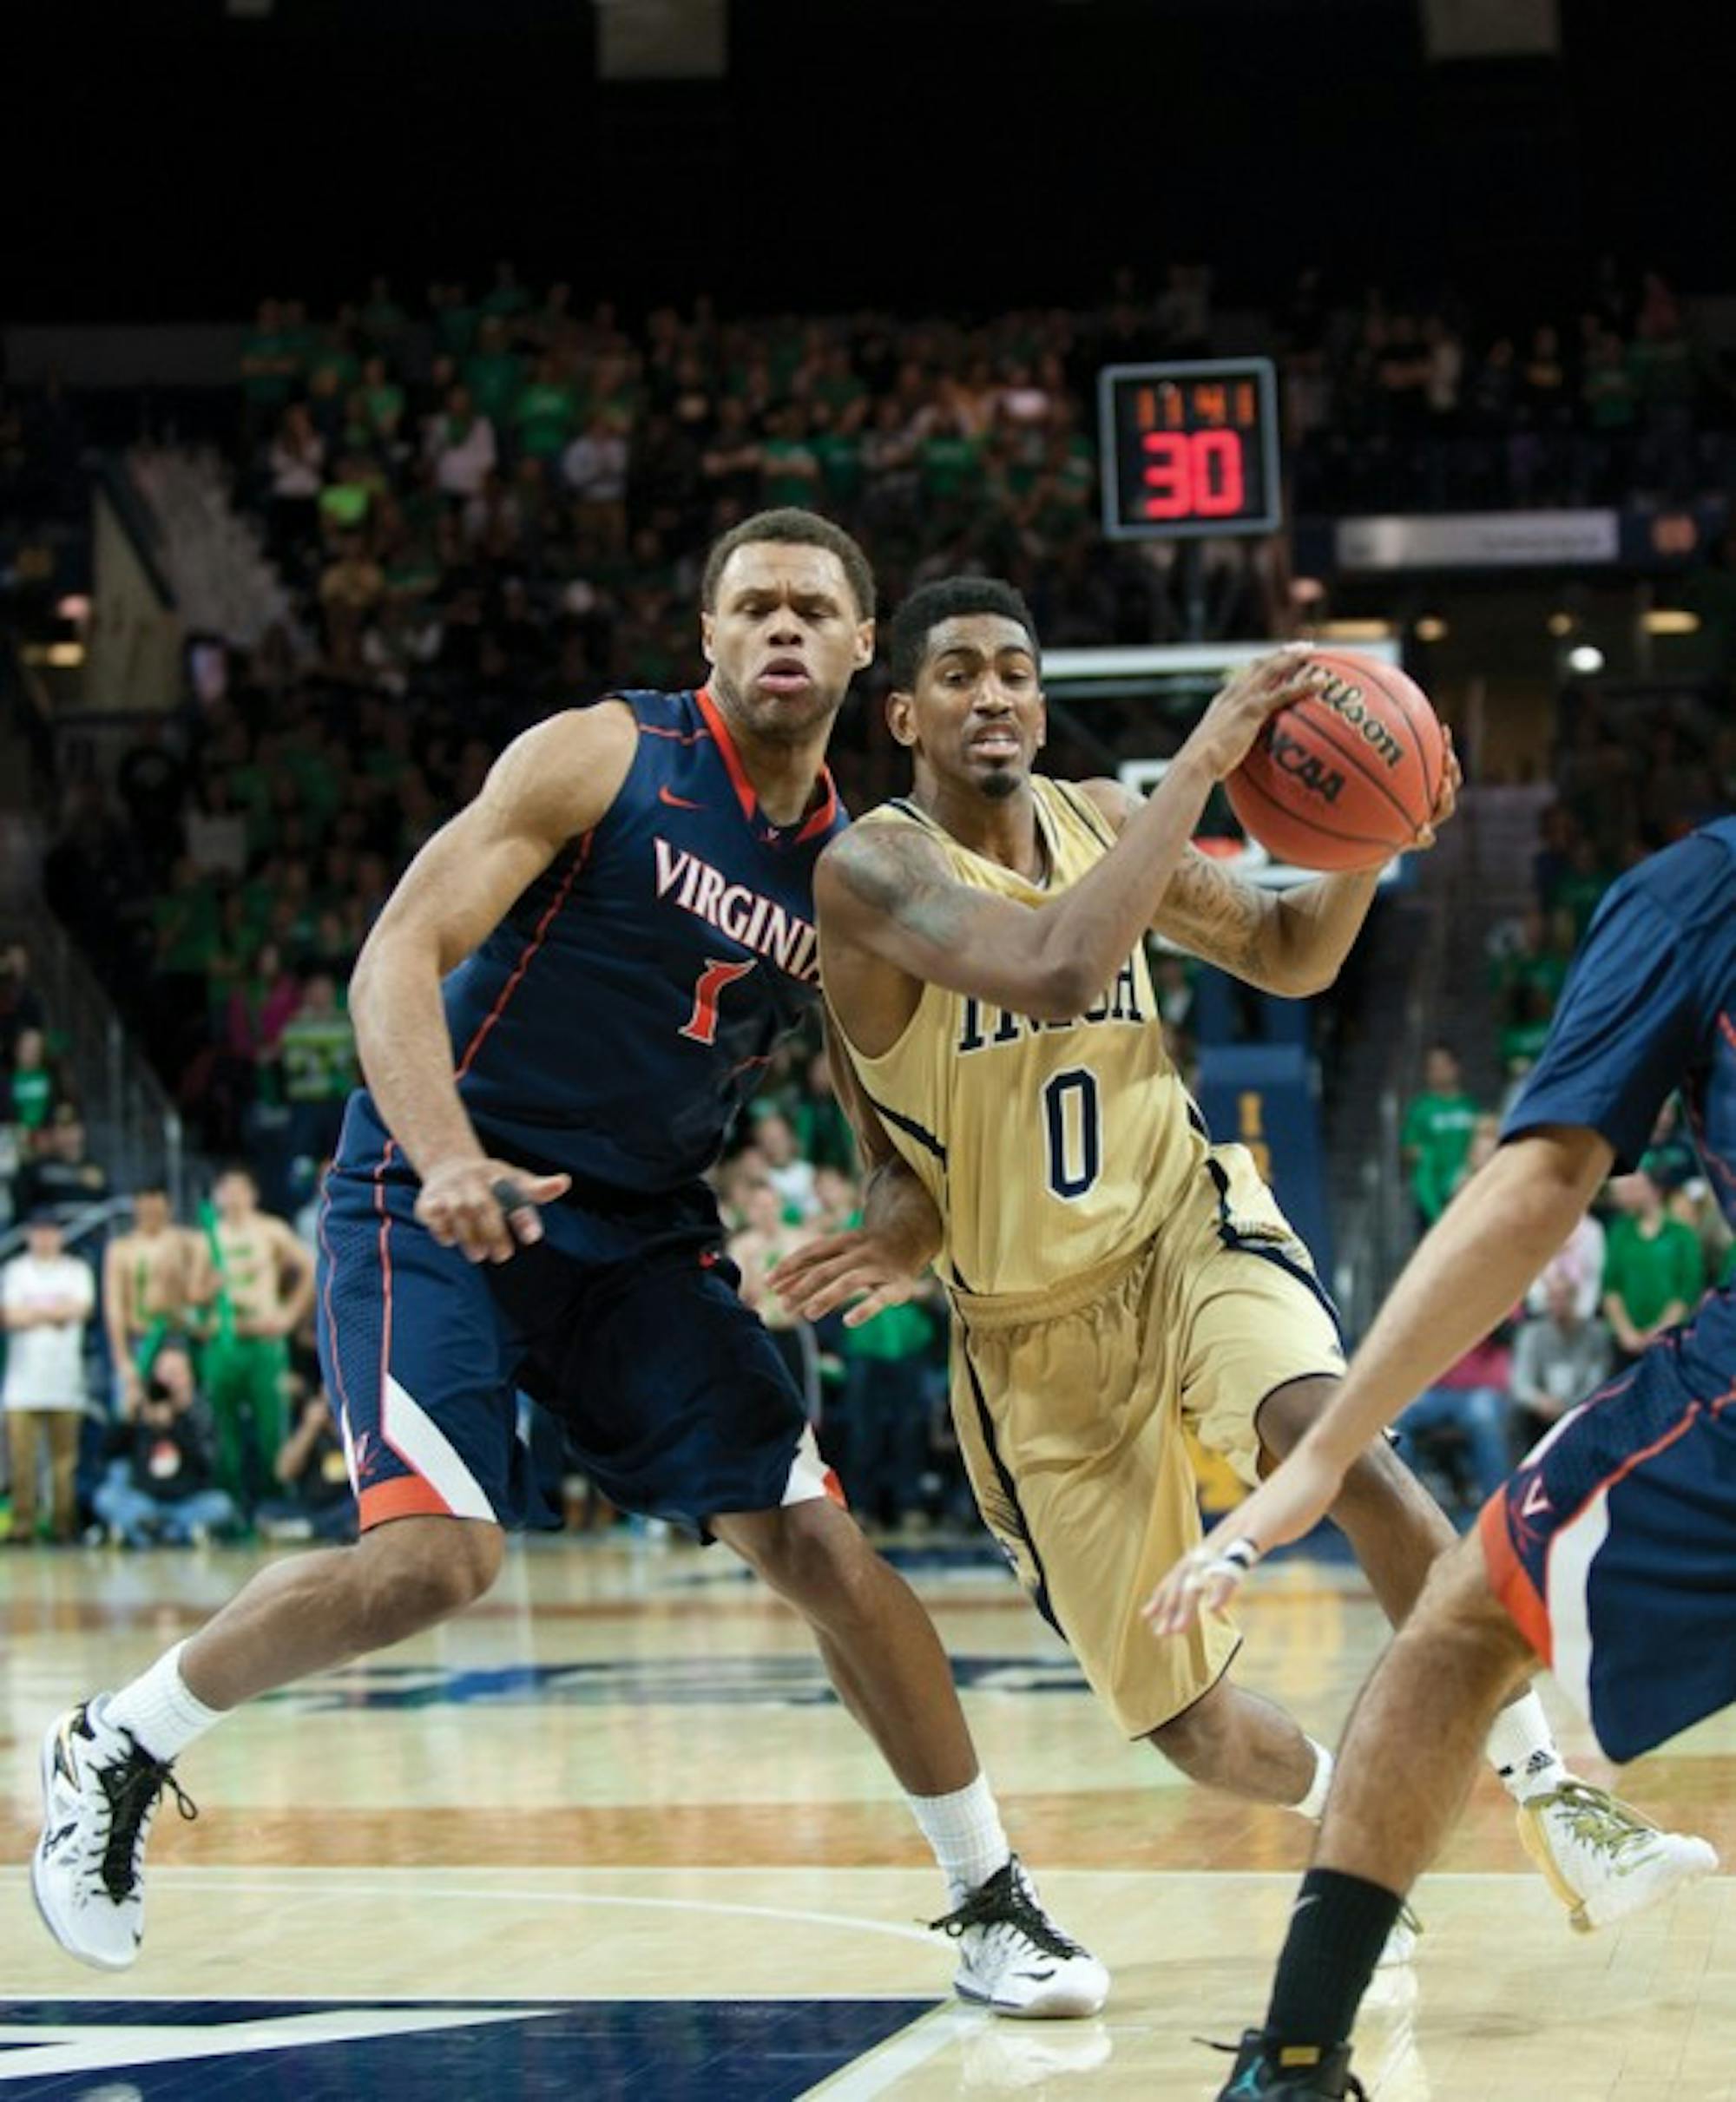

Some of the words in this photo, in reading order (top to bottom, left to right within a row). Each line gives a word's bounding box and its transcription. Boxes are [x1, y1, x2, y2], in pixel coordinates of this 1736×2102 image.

[1142, 428, 1244, 519] 30
[677, 957, 759, 1047] 1
[1041, 1064, 1102, 1203] 0
